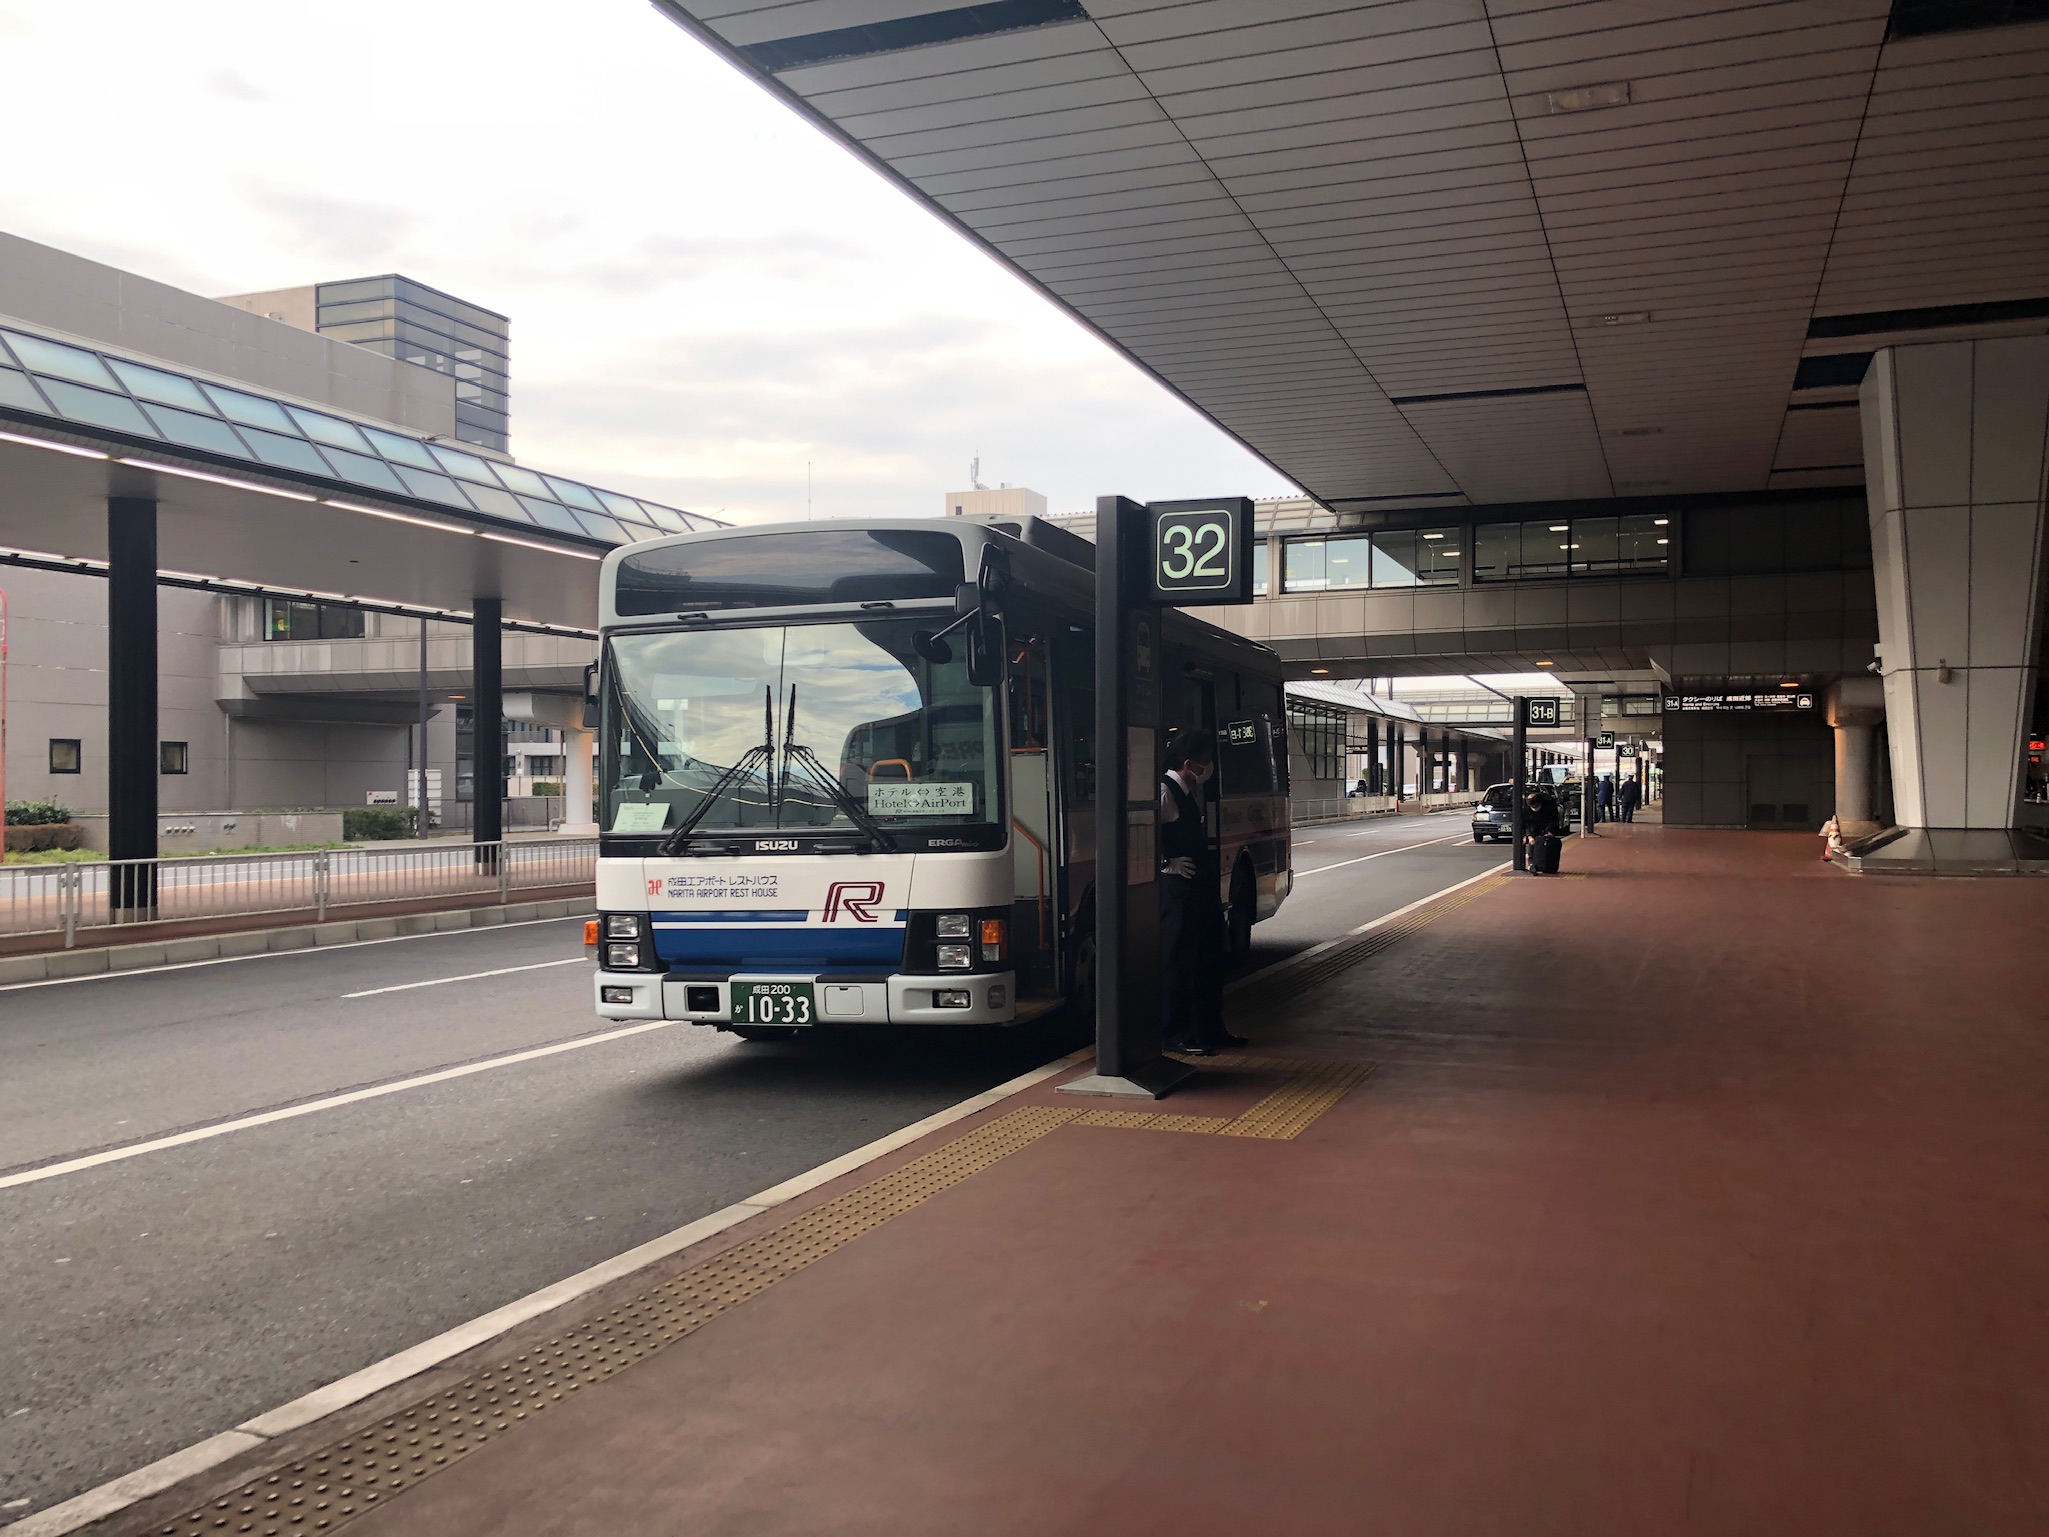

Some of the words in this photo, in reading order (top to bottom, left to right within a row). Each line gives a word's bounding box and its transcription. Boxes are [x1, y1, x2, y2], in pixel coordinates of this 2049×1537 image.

[1162, 523, 1226, 579] 32
[1532, 706, 1553, 719] 31-B
[1622, 746, 1633, 756] 30
[874, 788, 911, 797] ホテル
[935, 786, 966, 797] 空港
[875, 799, 907, 809] Hotel
[921, 799, 966, 808] AirPort
[755, 840, 799, 851] ISUZU
[668, 876, 727, 887] 成田エアポート
[729, 875, 778, 886] レストハウス
[667, 888, 695, 898] NARITA
[696, 888, 728, 898] AIRPORT
[730, 888, 749, 898] REST
[752, 888, 778, 898] HOUSE
[822, 881, 885, 923] R
[748, 995, 810, 1024] 10-33
